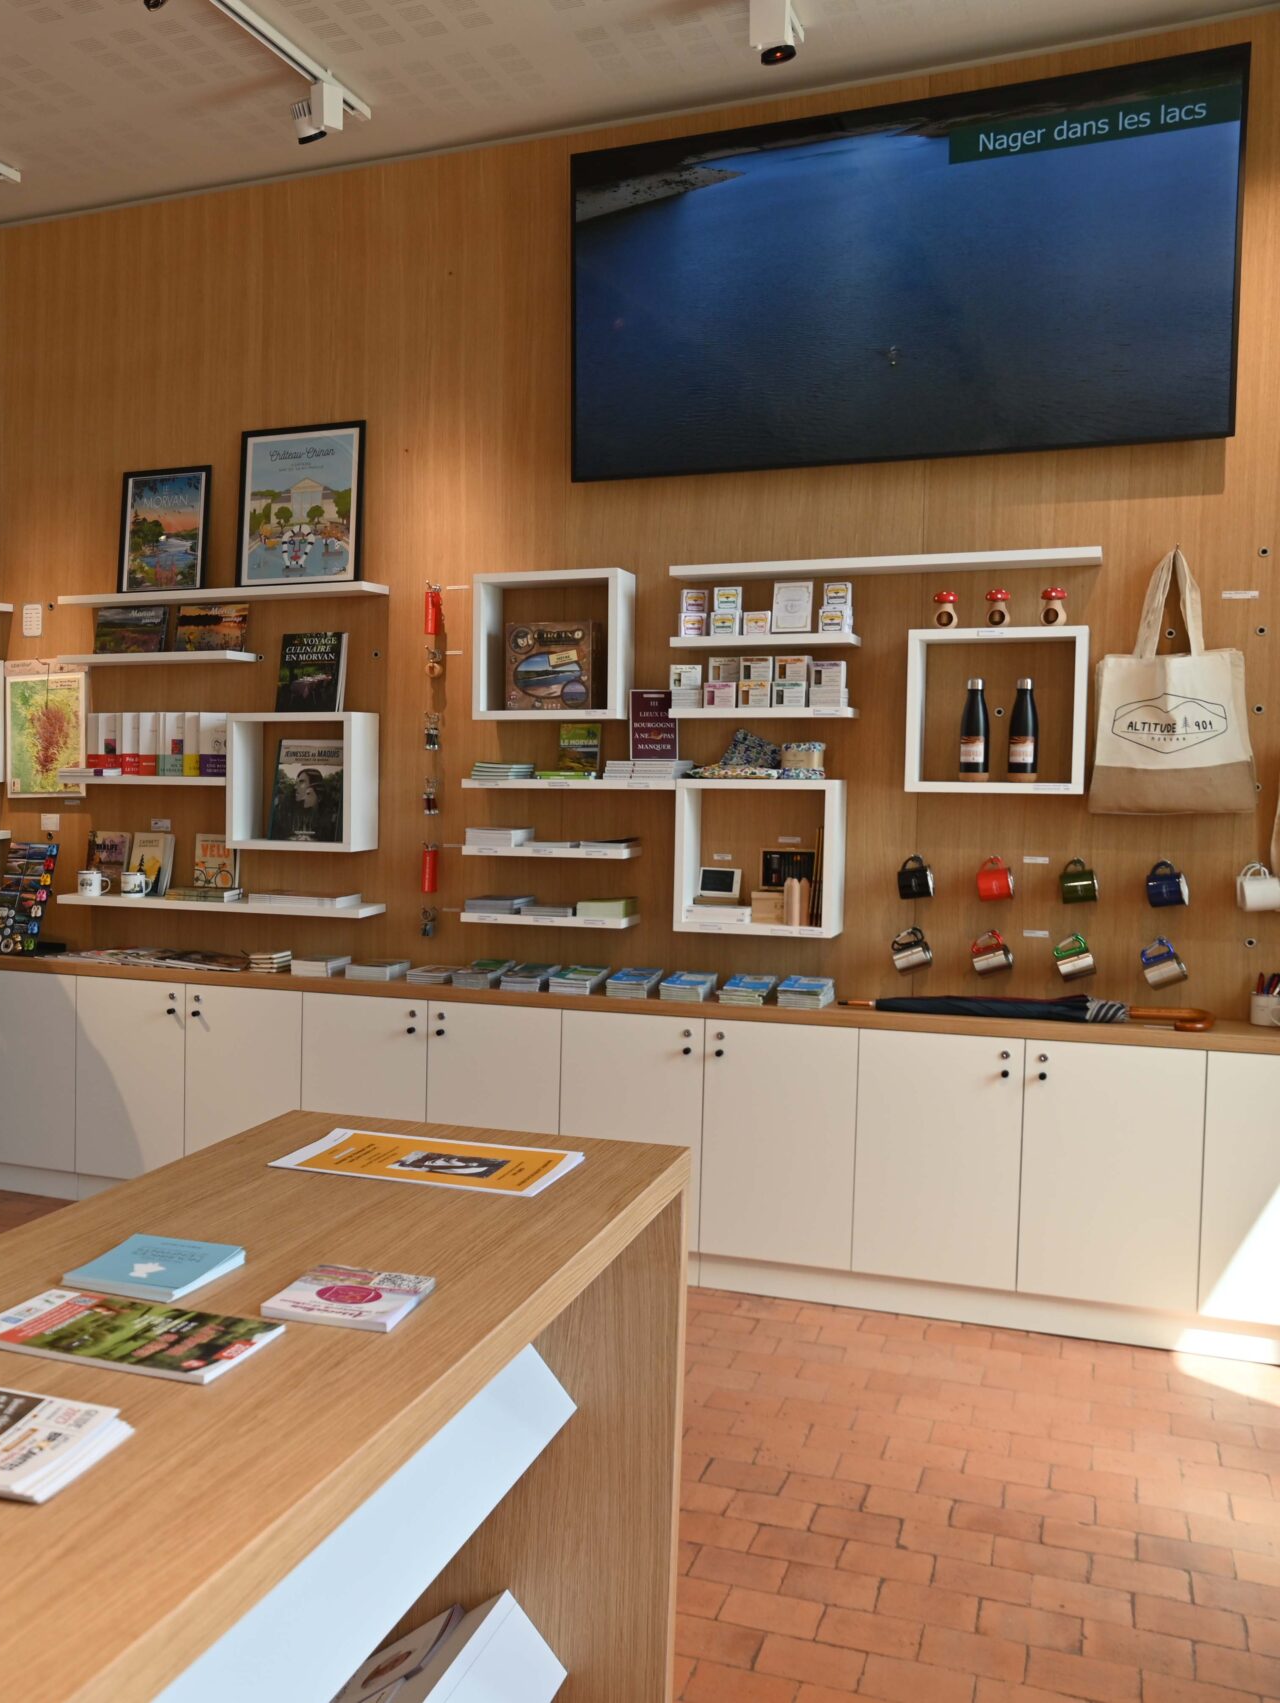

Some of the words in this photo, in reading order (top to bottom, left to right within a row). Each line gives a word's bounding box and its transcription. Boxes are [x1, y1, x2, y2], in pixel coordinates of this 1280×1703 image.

[979, 128, 1045, 152] Nager
[1053, 120, 1109, 141] dans
[1118, 111, 1151, 131] les
[1160, 102, 1207, 124] lacs
[143, 495, 188, 508] MORVAN
[303, 637, 337, 645] VOYAGE
[286, 645, 332, 653] CULINAIRE
[299, 653, 336, 661] MORVAN
[1127, 721, 1177, 733] ALTITUDE
[1194, 720, 1214, 731] 901
